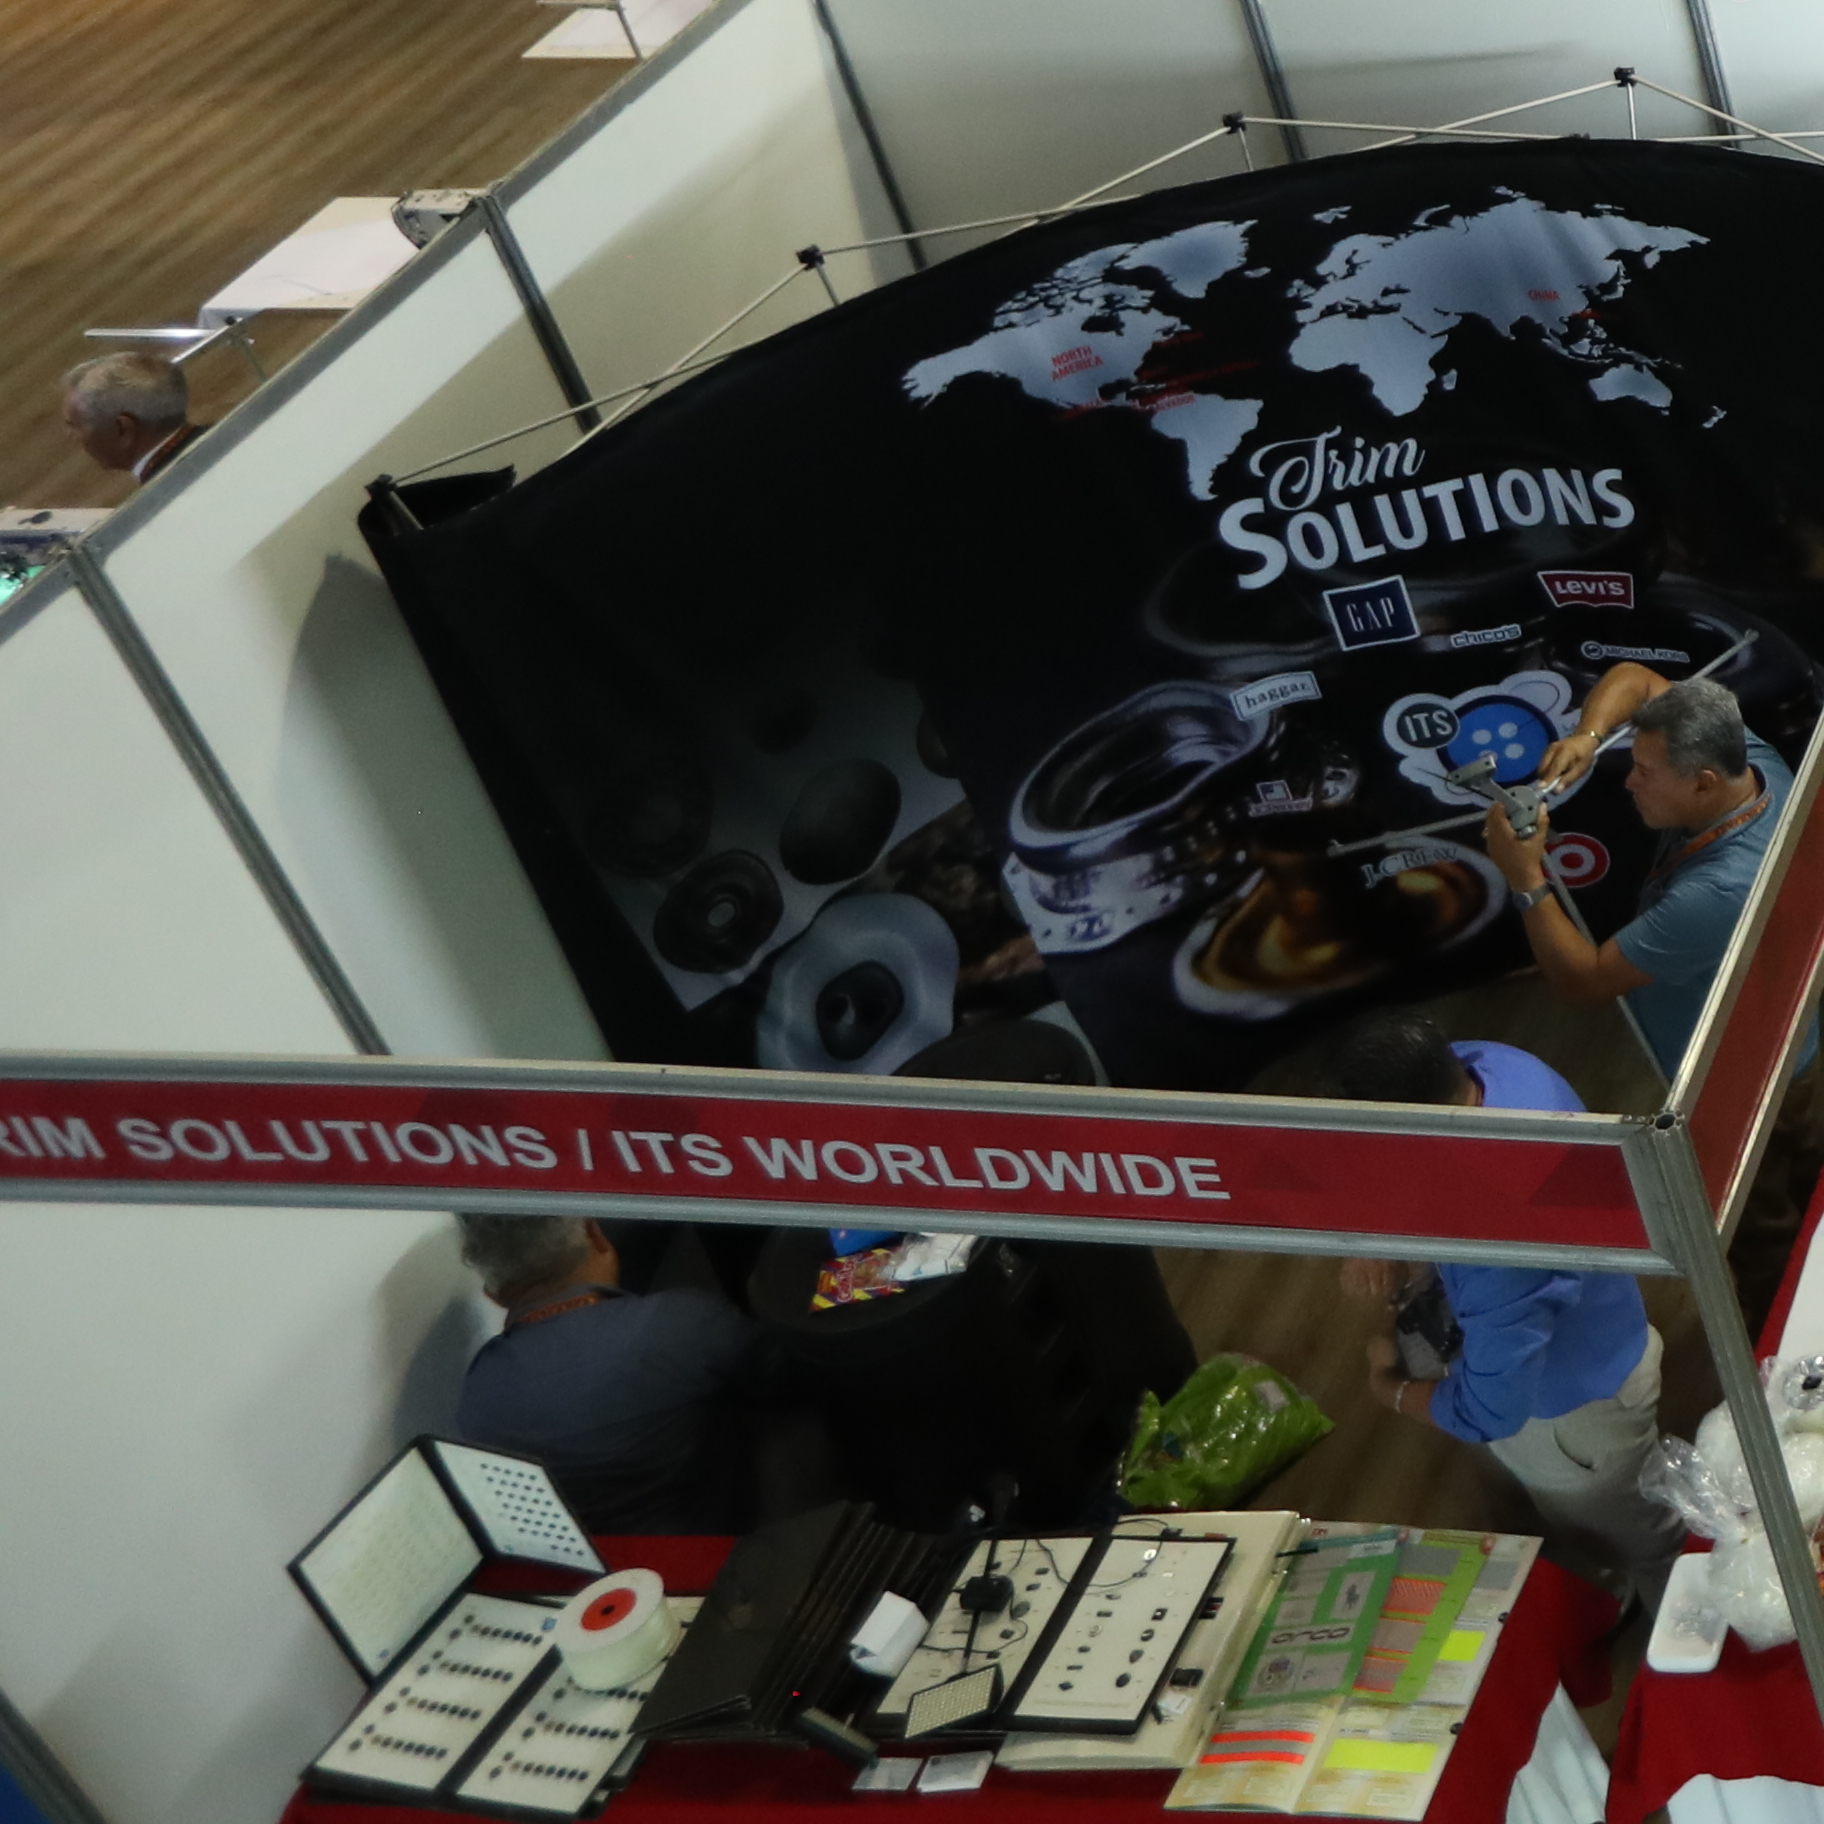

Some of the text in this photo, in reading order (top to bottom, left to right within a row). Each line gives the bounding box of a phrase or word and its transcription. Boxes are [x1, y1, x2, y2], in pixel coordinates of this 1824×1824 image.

[1528, 289, 1561, 303] CHINA
[1051, 345, 1092, 368] NORTH
[1051, 355, 1104, 381] AMERICA
[1248, 424, 1427, 512] Trim
[1218, 466, 1636, 591] SOLUTIONS
[1346, 596, 1396, 634] GAP
[1402, 708, 1454, 739] ITS
[118, 1118, 558, 1171] SOLUTIONS
[613, 1129, 734, 1177] ITS
[742, 1134, 1232, 1199] WORLDWIDE
